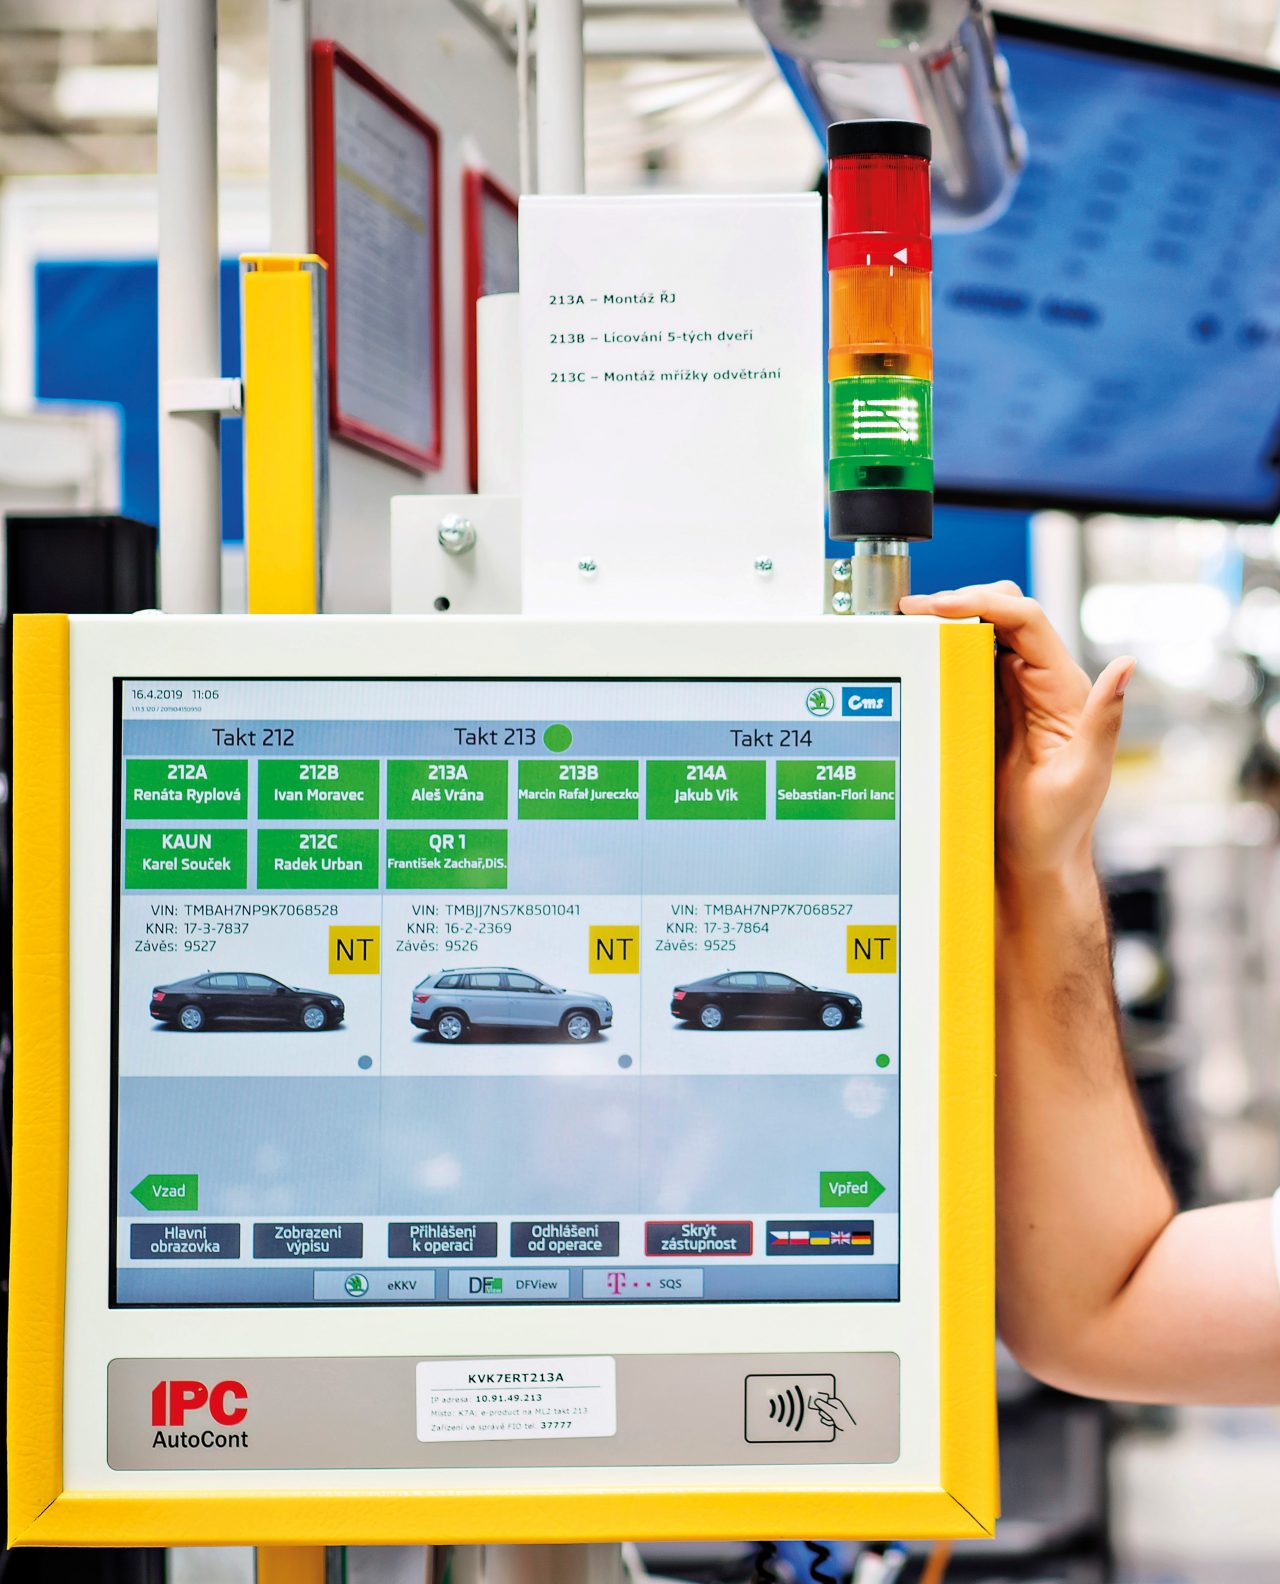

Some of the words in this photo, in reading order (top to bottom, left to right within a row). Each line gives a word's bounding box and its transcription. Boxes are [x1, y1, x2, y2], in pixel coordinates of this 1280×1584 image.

[549, 295, 584, 305] 213A
[603, 292, 655, 304] Montáž
[660, 290, 676, 303] ŘJ
[549, 333, 585, 344] 213B
[667, 331, 712, 345] 5-tých
[717, 330, 753, 341] dveří
[550, 372, 586, 383] 213C
[604, 370, 656, 382] Montáž
[660, 370, 708, 382] mřížky
[713, 368, 781, 381] odvětrání
[132, 689, 183, 700] 16.4.2019
[192, 689, 219, 700] 11:06
[212, 727, 257, 746] Takt
[262, 728, 295, 747] 212
[454, 727, 498, 745] Takt
[504, 728, 536, 746] 213
[730, 729, 774, 747] Takt
[780, 730, 812, 747] 214
[167, 764, 208, 780] 212A
[299, 764, 339, 780] 212B
[428, 764, 468, 780] 213A
[559, 765, 599, 780] 213B
[686, 765, 727, 780] 214A
[816, 765, 856, 781] 214B
[133, 787, 184, 801] Renáta
[186, 787, 241, 804] Ryplová
[274, 788, 303, 801] Ivan
[307, 788, 364, 801] Moravec
[411, 788, 441, 801] Aleš
[444, 788, 484, 801] Vrána
[518, 788, 556, 800] Marcin
[559, 788, 589, 800] Rafał
[590, 788, 639, 801] Jureczko
[674, 788, 713, 803] Jakub
[715, 788, 738, 802] Vik
[777, 788, 867, 800] Sebastian-Flori
[161, 833, 212, 849] KAUN
[299, 834, 338, 849] 212C
[429, 834, 454, 852] QR
[457, 834, 466, 849] 1
[142, 857, 178, 871] Karel
[181, 857, 231, 871] Souček
[274, 857, 317, 871] Radek
[320, 857, 363, 871] Urban
[387, 857, 441, 868] František
[151, 904, 178, 916] VIN:
[184, 904, 339, 916] TMBAH7NP9K7068528
[411, 904, 439, 916] VIN:
[445, 904, 580, 918] TMBJJ7NS7K8501041
[671, 904, 698, 915] VIN:
[704, 904, 853, 916] TMBAH7NP7K7068527
[146, 922, 178, 934] KNR:
[184, 922, 249, 934] 17-3-7837
[407, 923, 439, 934] KNR:
[445, 923, 512, 934] 16-2-2369
[666, 922, 698, 934] KNR:
[704, 922, 769, 934] 17-3-7864
[134, 940, 178, 952] Závěs:
[184, 940, 217, 952] 9527
[336, 938, 374, 961] NT
[396, 940, 439, 952] Závěs:
[445, 940, 478, 951] 9526
[596, 938, 633, 960] NT
[655, 939, 698, 951] Závěs:
[704, 940, 736, 951] 9525
[854, 938, 890, 960] NT
[152, 1184, 186, 1198] Vzad
[828, 1181, 868, 1197] Vpřed
[681, 1223, 717, 1239] Skrýt
[150, 1239, 220, 1253] obrazovka
[286, 1239, 330, 1255] výpisu
[412, 1238, 421, 1251] k
[424, 1238, 473, 1254] operaci
[528, 1238, 545, 1251] od
[548, 1240, 603, 1254] operace
[661, 1237, 737, 1253] zástupnost
[387, 1280, 417, 1291] eKKV
[516, 1279, 558, 1290] DFView
[659, 1279, 682, 1289] SQS
[468, 1372, 564, 1384] KVK7ERT213A
[151, 1380, 248, 1427] IPC
[476, 1394, 542, 1402] 10.91.49.213
[540, 1421, 572, 1429] 37777
[152, 1430, 248, 1448] AutoCont
